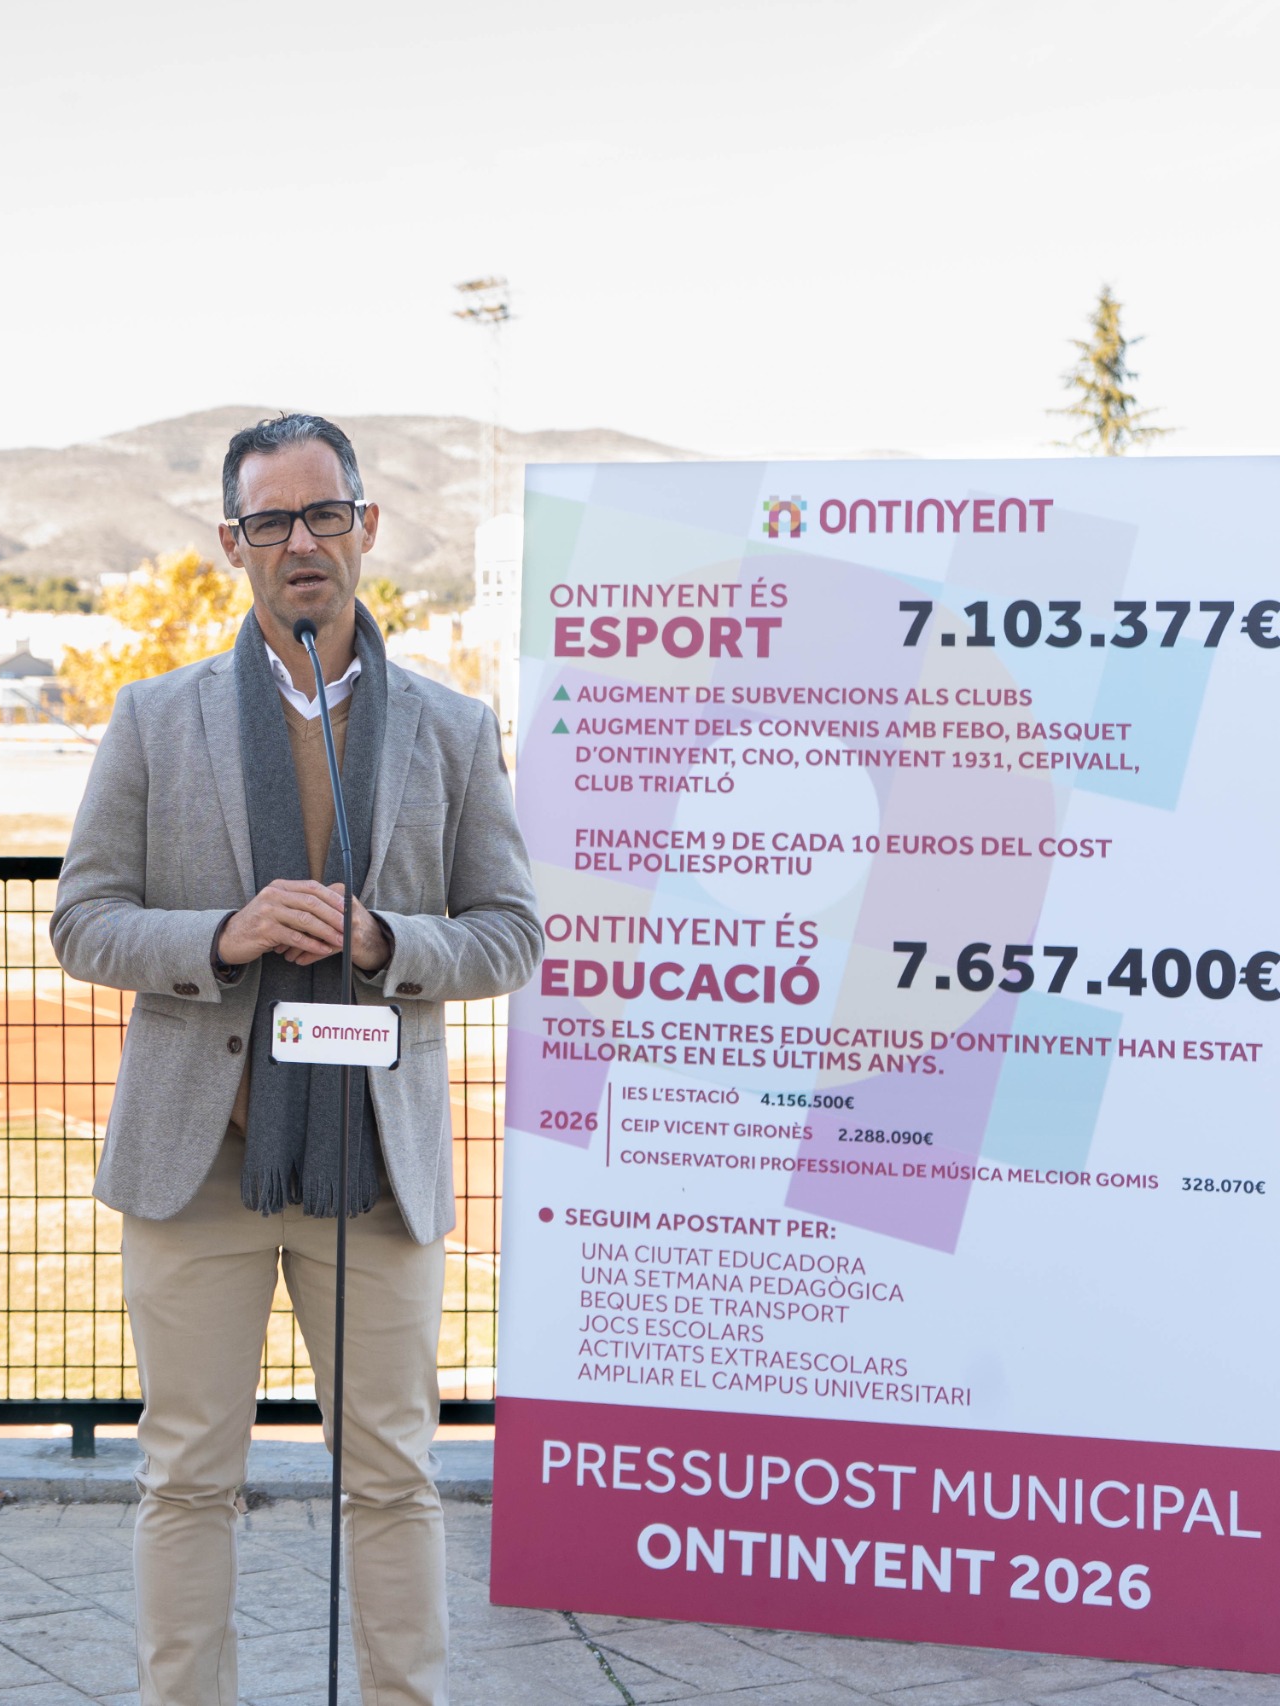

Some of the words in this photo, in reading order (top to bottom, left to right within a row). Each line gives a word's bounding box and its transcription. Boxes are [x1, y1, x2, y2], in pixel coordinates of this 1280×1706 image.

[819, 497, 1054, 534] ONTINYENT
[549, 583, 743, 608] ONTINYENT
[750, 576, 788, 609] ÉS
[554, 616, 783, 659] ESPORT
[899, 599, 1280, 649] 7.103.377€
[576, 685, 691, 704] AUGMENT
[695, 686, 726, 704] DE
[731, 686, 899, 706] SUBVENCIONS
[903, 687, 949, 706] ALS
[954, 688, 1033, 707] CLUBS
[575, 717, 690, 736] AUGMENT
[694, 718, 753, 737] DELS
[758, 718, 880, 739] CONVENIS
[884, 720, 937, 739] AMB
[942, 721, 1010, 743] FEBO,
[1016, 722, 1132, 742] BASQUET
[575, 745, 736, 768] D'ONTINYENT,
[741, 748, 800, 769] CNO,
[805, 748, 946, 768] ONTINYENT
[952, 751, 1012, 773] 1931,
[1018, 751, 1140, 774] CEPIVALL,
[574, 774, 634, 792] CLUB
[638, 771, 735, 794] TRIATLÓ
[575, 828, 706, 850] FINANCEM
[712, 831, 726, 851] 9
[732, 831, 766, 851] DE
[771, 832, 845, 853] CADA
[852, 835, 881, 854] 10
[886, 834, 974, 856] EUROS
[981, 836, 1033, 857] DEL
[1038, 837, 1113, 858] COST
[574, 851, 623, 872] DEL
[628, 852, 812, 876] POLIESPORTIU
[544, 913, 766, 947] ONTINYENT
[775, 912, 819, 950] ÉS
[540, 955, 820, 1006] EDUCACIÓ
[892, 941, 1280, 1002] 7.657.400€
[312, 1025, 390, 1042] ONTINYENT
[542, 1017, 606, 1038] TOTS
[611, 1019, 655, 1040] ELS
[660, 1021, 775, 1044] CENTRES
[779, 1026, 924, 1050] EDUCATIUS
[930, 1031, 1113, 1057] D'ONTINYENT
[1118, 1038, 1176, 1059] HAN
[1183, 1040, 1264, 1062] ESTAT
[542, 1040, 677, 1064] MILLORATS
[683, 1046, 716, 1066] EN
[722, 1047, 767, 1068] ELS
[773, 1043, 862, 1072] ÚLTIMS
[867, 1053, 945, 1075] ANYS.
[622, 1086, 648, 1101] IES
[652, 1086, 740, 1105] L'ESTACIÓ
[760, 1092, 855, 1110] 4.156.500€
[539, 1109, 598, 1132] 2026
[620, 1118, 660, 1133] CEIP
[663, 1119, 730, 1136] VICENT
[733, 1121, 814, 1142] GIRONÈS
[838, 1128, 934, 1146] 2.288.090€
[620, 1149, 756, 1170] CONSERVATORI
[760, 1156, 899, 1177] PROFESSIONAL
[902, 1163, 927, 1178] DE
[930, 1161, 1003, 1182] MÚSICA
[1007, 1168, 1091, 1186] MELCIOR
[1095, 1172, 1159, 1190] GOMIS
[1181, 1177, 1266, 1195] 328.070€
[565, 1207, 651, 1230] SEGUIM
[655, 1212, 782, 1236] APOSTANT
[786, 1219, 836, 1240] PER:
[582, 1242, 629, 1262] UNA
[634, 1244, 714, 1267] CIUTAT
[718, 1249, 866, 1276] EDUCADORA
[581, 1265, 629, 1286] UNA
[633, 1268, 744, 1293] SETMANA
[749, 1275, 905, 1303] PEDAGÒGICA
[580, 1289, 668, 1313] BEQUES
[674, 1295, 704, 1315] DE
[709, 1297, 850, 1324] TRANSPORT
[578, 1314, 639, 1336] JOCS
[645, 1318, 764, 1344] ESCOLARS
[578, 1338, 705, 1364] ACTIVITATS
[711, 1346, 908, 1377] EXTRAESCOLARS
[577, 1362, 674, 1386] AMPLIAR
[680, 1368, 707, 1389] EL
[711, 1371, 808, 1396] CAMPUS
[814, 1377, 971, 1407] UNIVERSITARI
[542, 1439, 917, 1511] PRESSUPOST
[932, 1468, 1262, 1539] MUNICIPAL
[637, 1522, 996, 1596] ONTINYENT
[1009, 1554, 1152, 1610] 2026
